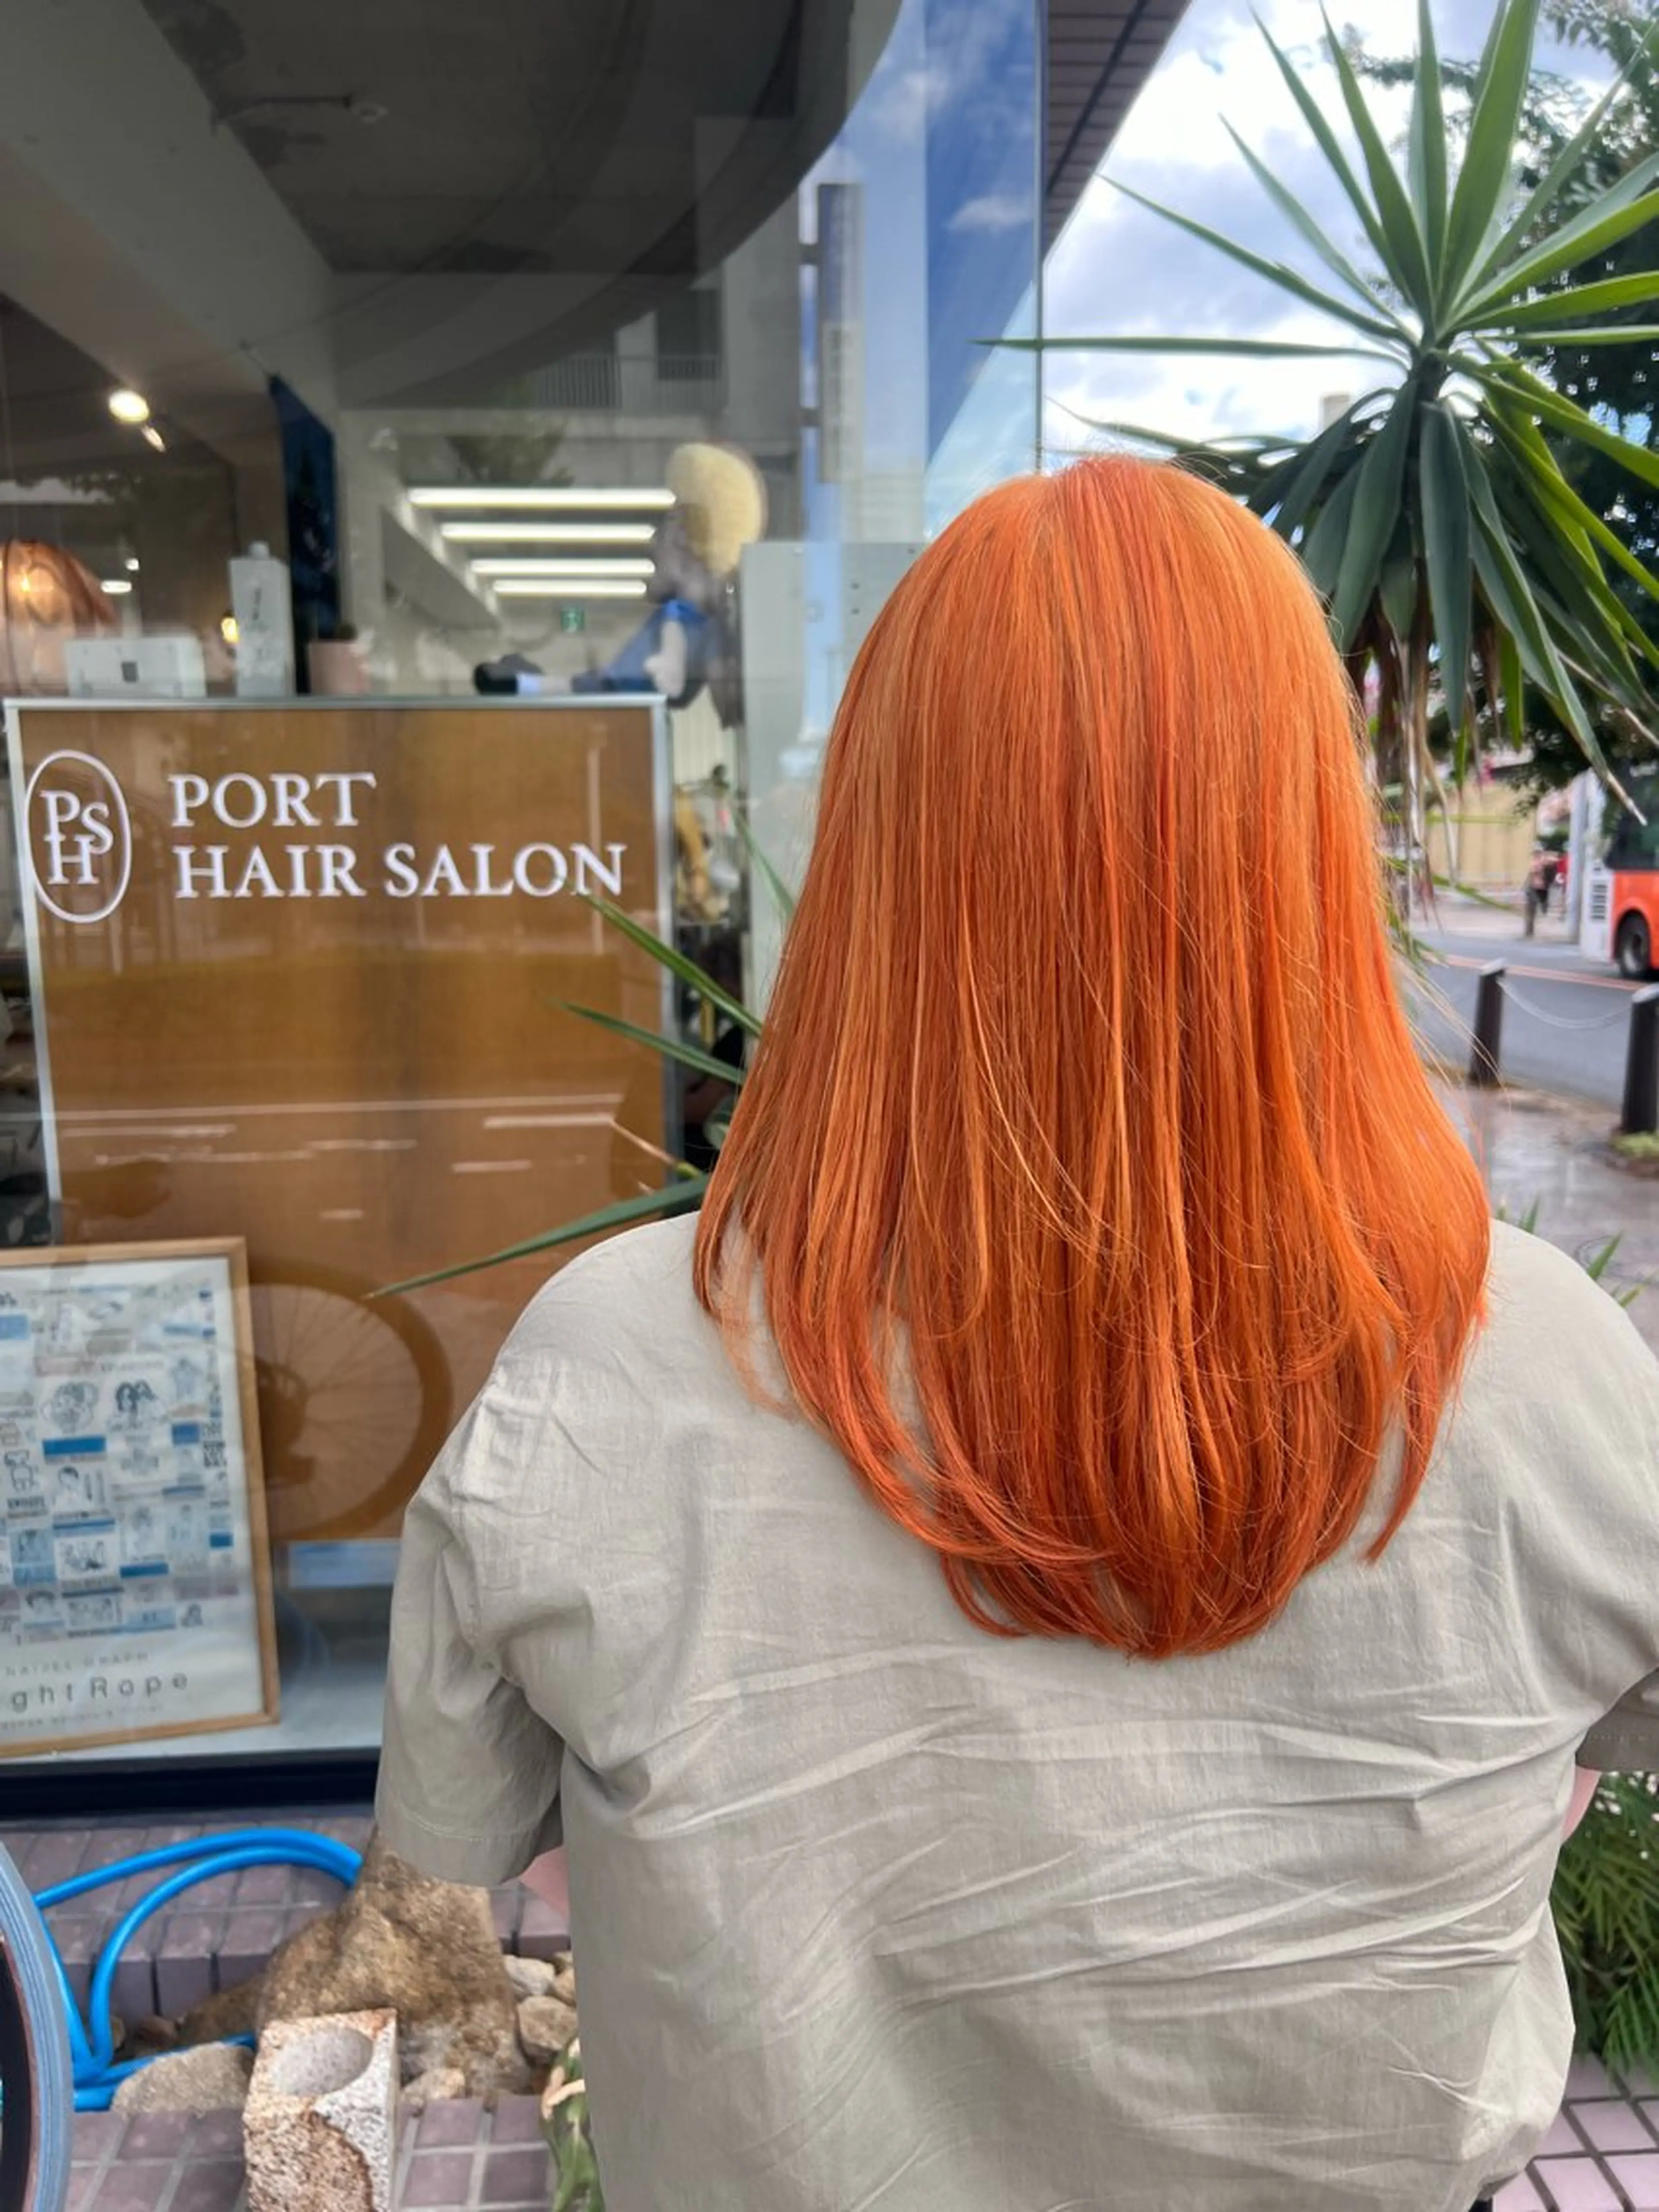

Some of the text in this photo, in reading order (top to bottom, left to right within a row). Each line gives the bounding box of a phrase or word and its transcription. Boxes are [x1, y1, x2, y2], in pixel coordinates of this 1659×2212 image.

[168, 772, 377, 828] PORT
[172, 842, 627, 898] HAIR SALON
[89, 1672, 188, 1699] Rope
